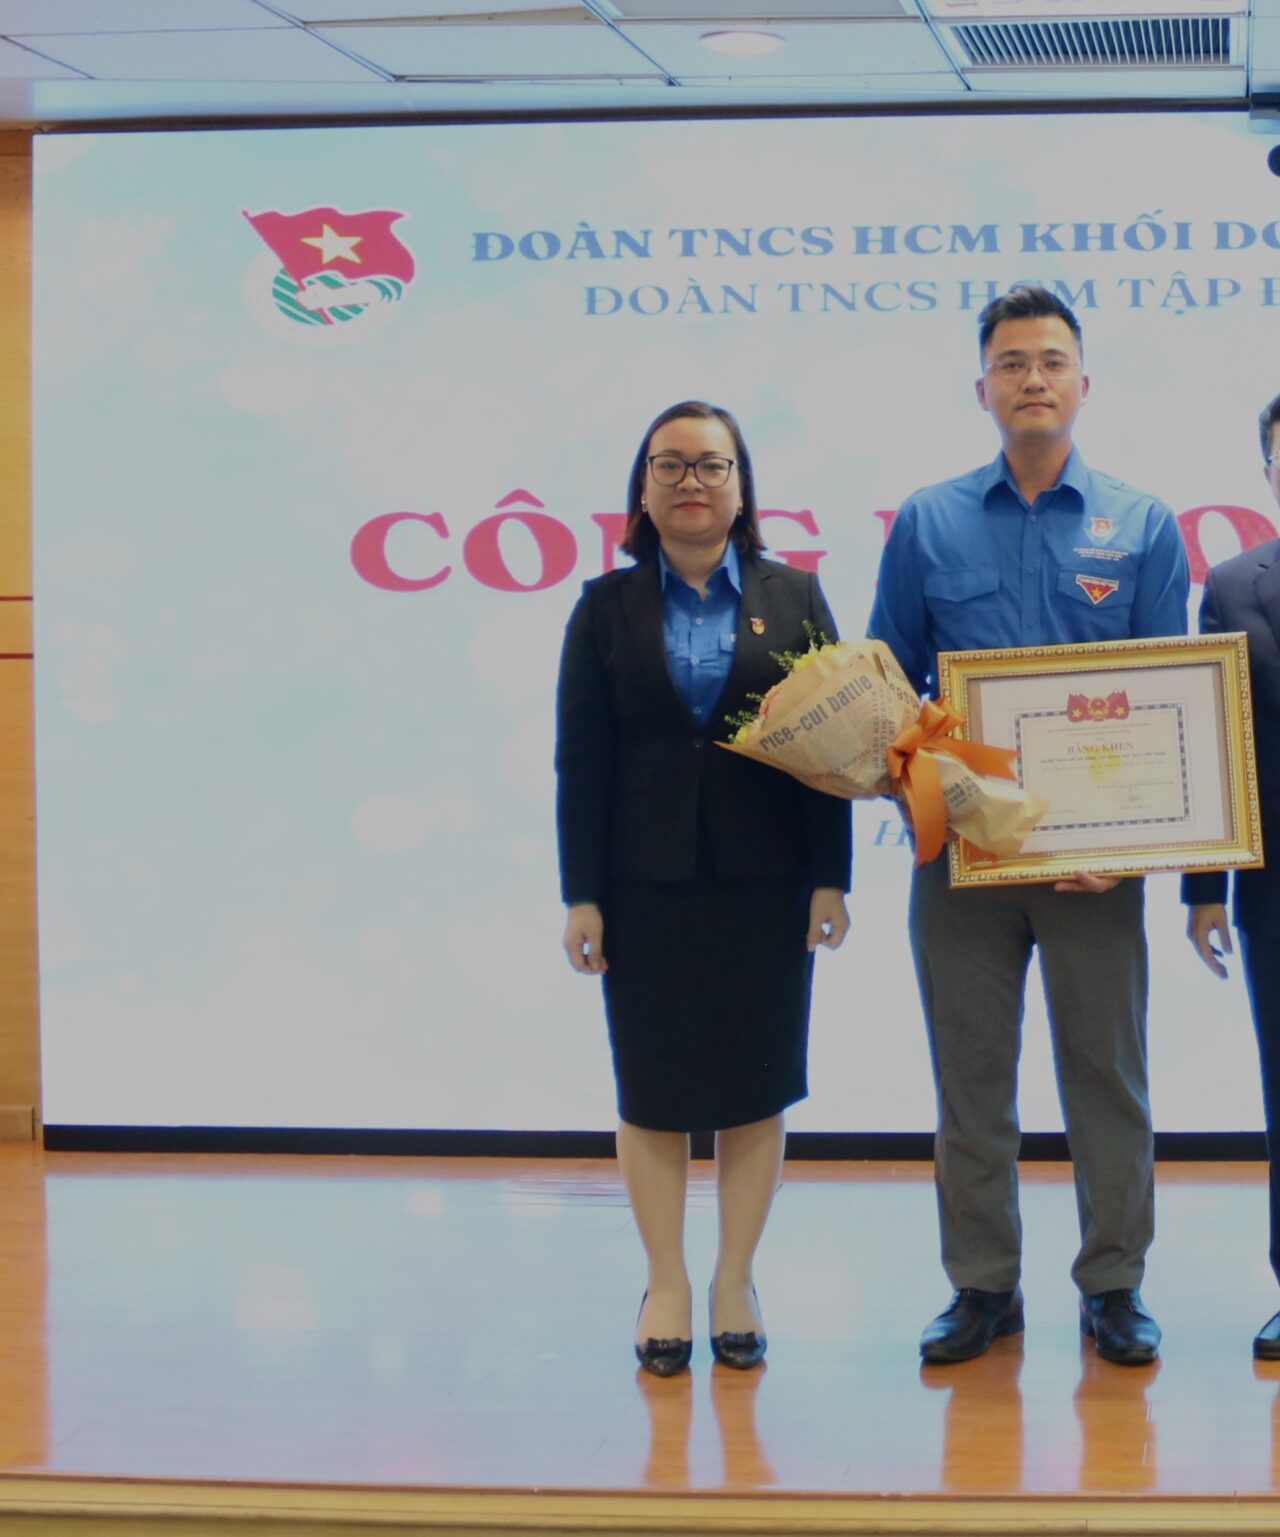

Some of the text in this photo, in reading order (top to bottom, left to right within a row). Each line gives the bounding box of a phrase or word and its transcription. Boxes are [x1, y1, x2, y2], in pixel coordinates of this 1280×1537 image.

[471, 221, 651, 262] ĐOÀN
[668, 226, 834, 258] TNCS
[853, 223, 1000, 255] HCM
[1018, 209, 1193, 253] KHỐI
[583, 277, 760, 316] ĐOÀN
[776, 281, 939, 314] TNCS
[1118, 271, 1242, 316] TẬP
